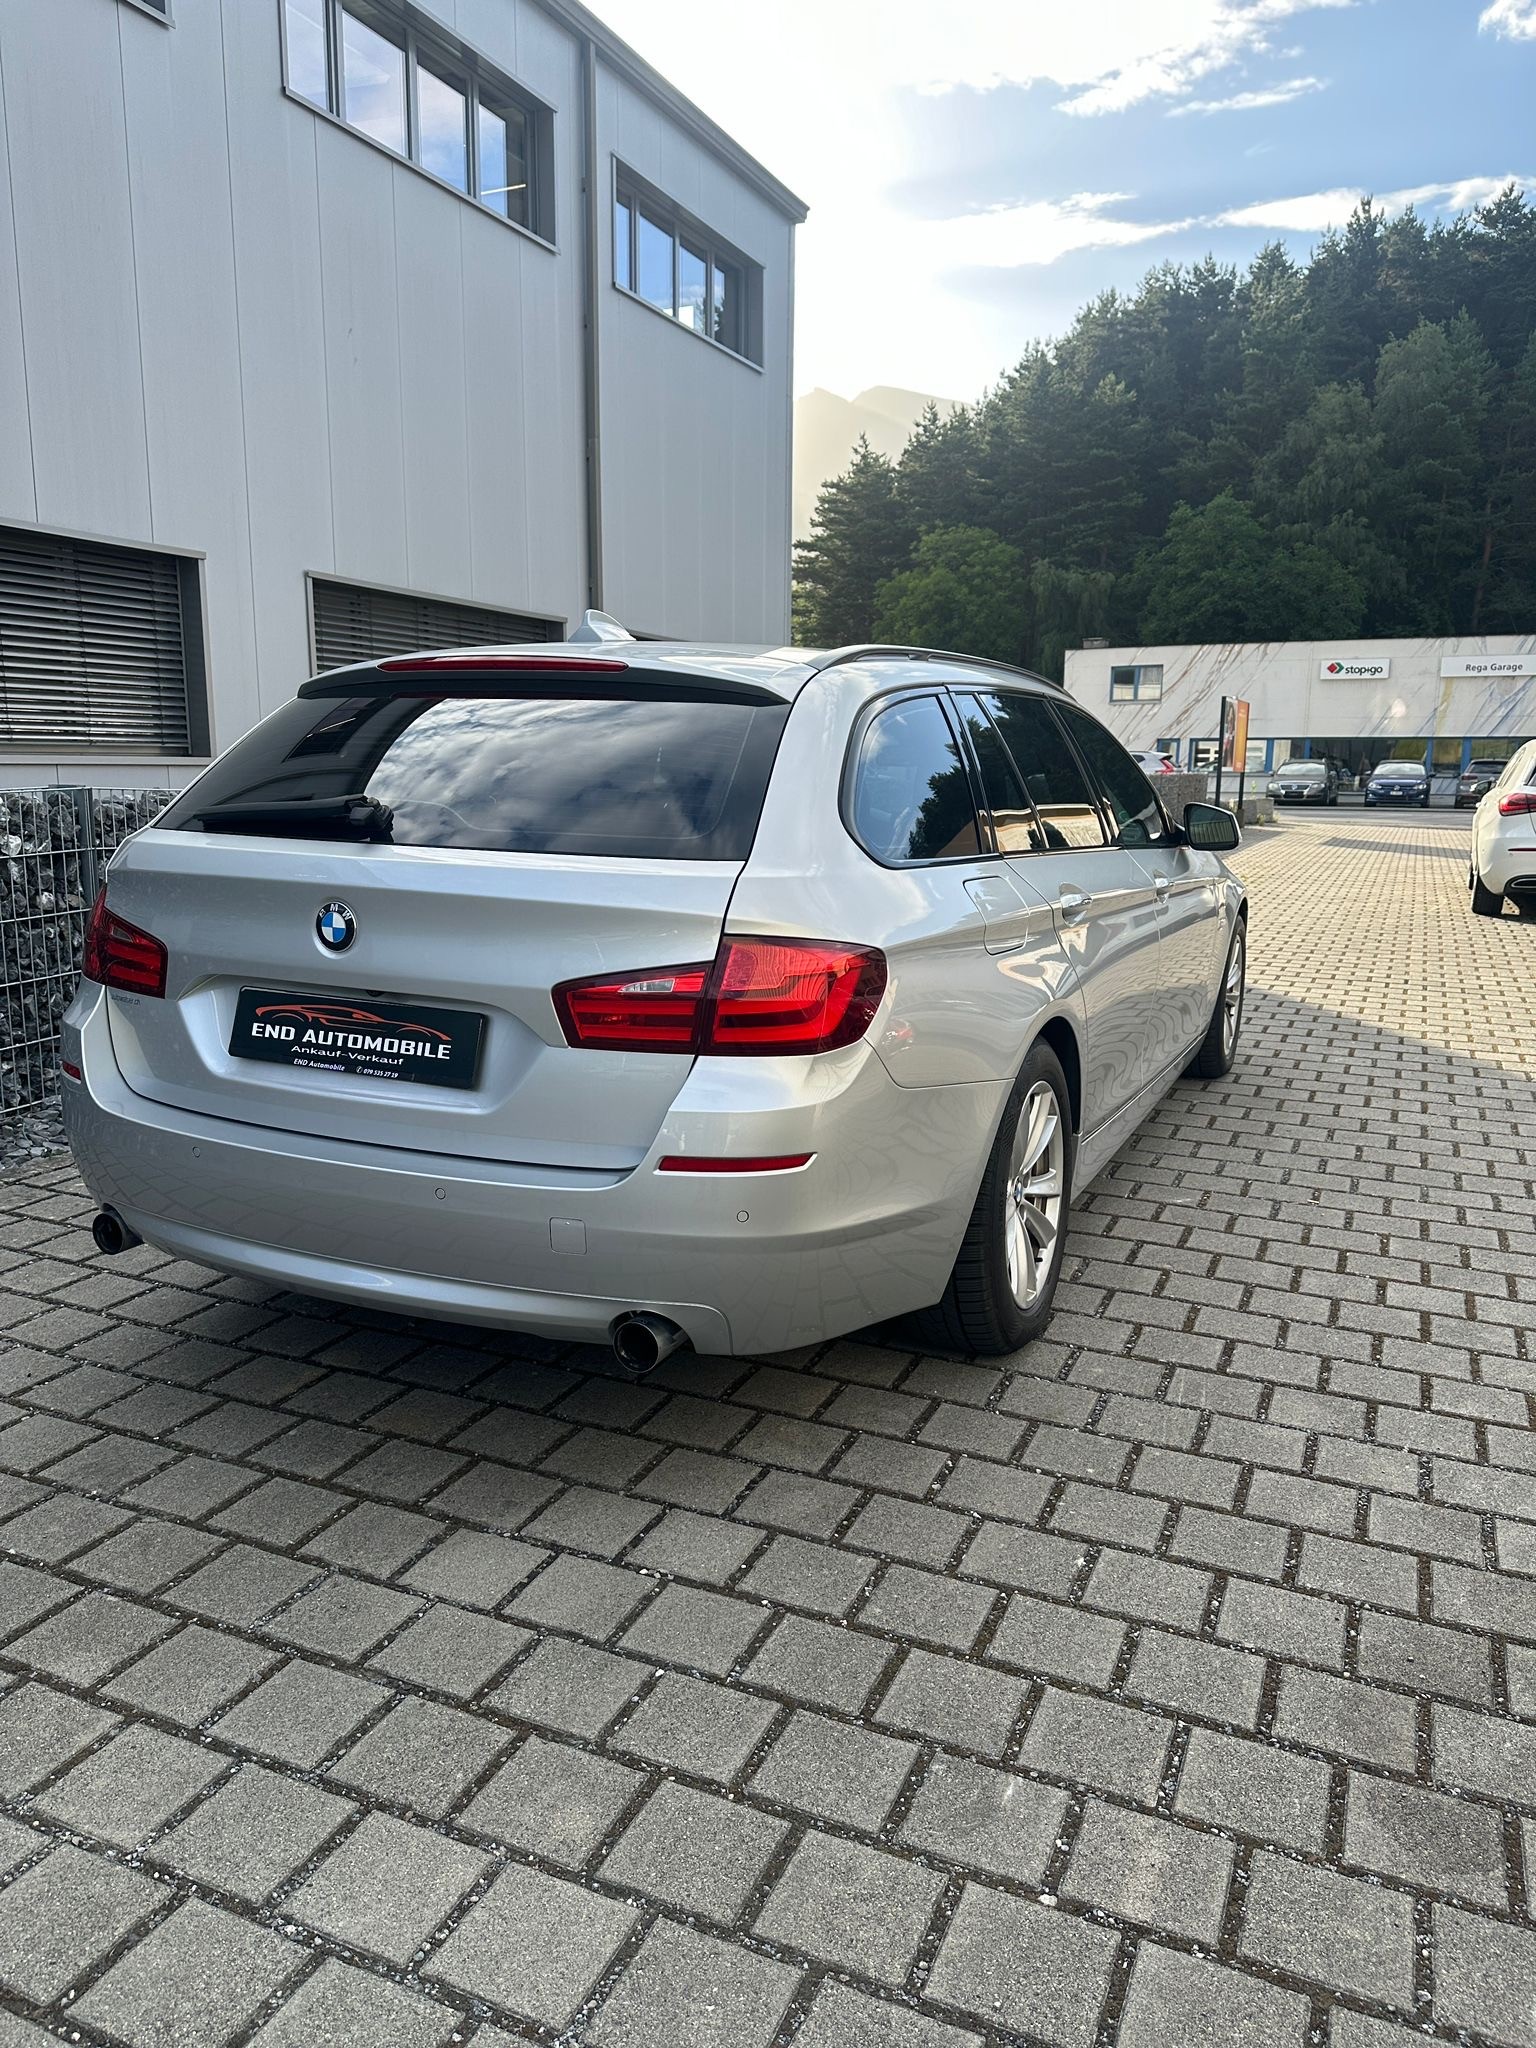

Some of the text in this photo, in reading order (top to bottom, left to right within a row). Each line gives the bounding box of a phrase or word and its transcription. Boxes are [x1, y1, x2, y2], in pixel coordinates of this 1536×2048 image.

[1345, 666, 1383, 676] stop+go
[1465, 662, 1524, 673] Rega Garage
[318, 904, 352, 921] BMW
[252, 1022, 452, 1060] END AUTOMOBILE
[291, 1046, 404, 1065] Ankauf-Verkauf
[293, 1058, 346, 1072] END Automobile
